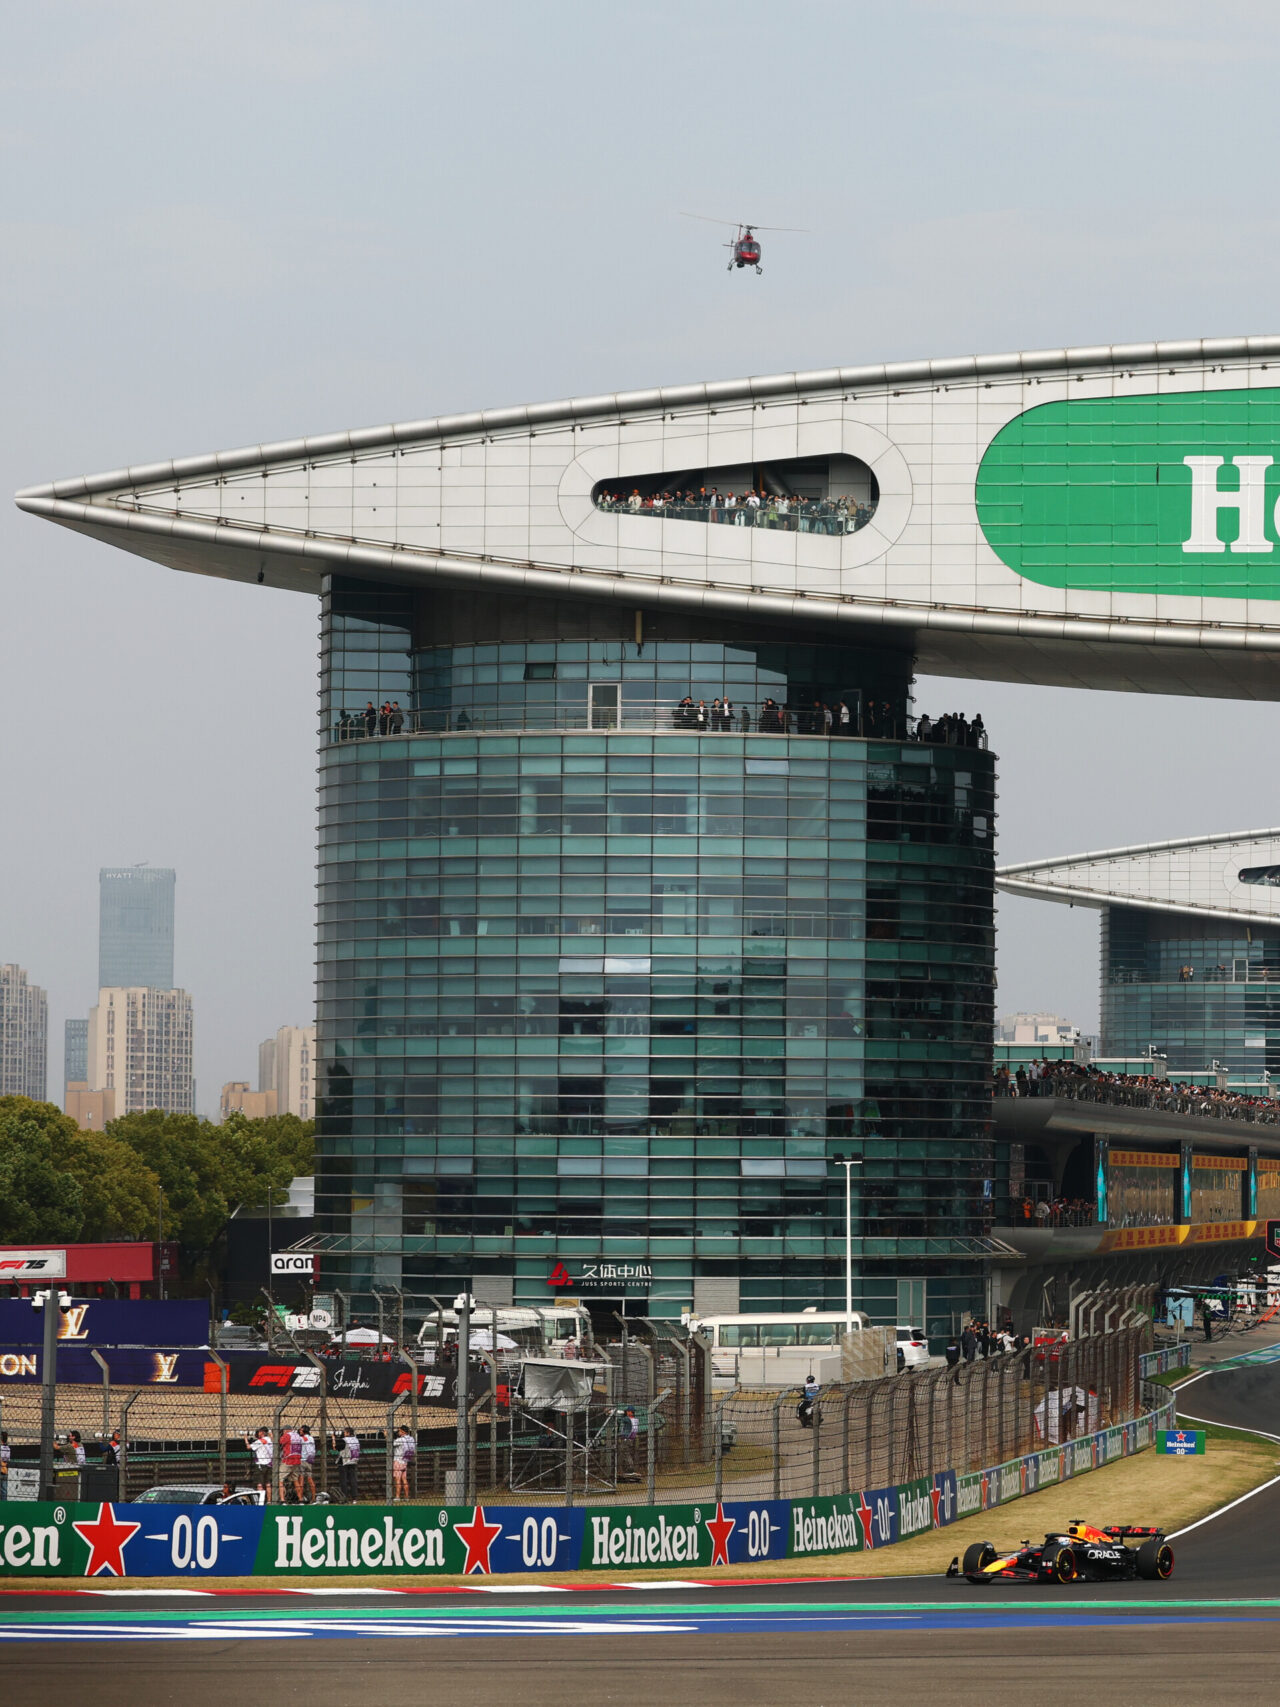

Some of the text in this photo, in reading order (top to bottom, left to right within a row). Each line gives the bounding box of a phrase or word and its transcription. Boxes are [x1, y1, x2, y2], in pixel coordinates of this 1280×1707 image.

[582, 1264, 652, 1278] 久体中心
[313, 1314, 327, 1323] MP4
[333, 1366, 370, 1399] Shanghai
[0, 1514, 219, 1569] en 0.0
[274, 1516, 558, 1568] Heineken 0.0
[591, 1509, 769, 1565] Heineken 0.0
[793, 1504, 858, 1552] Heineken
[1088, 1549, 1121, 1559] ORACLE
